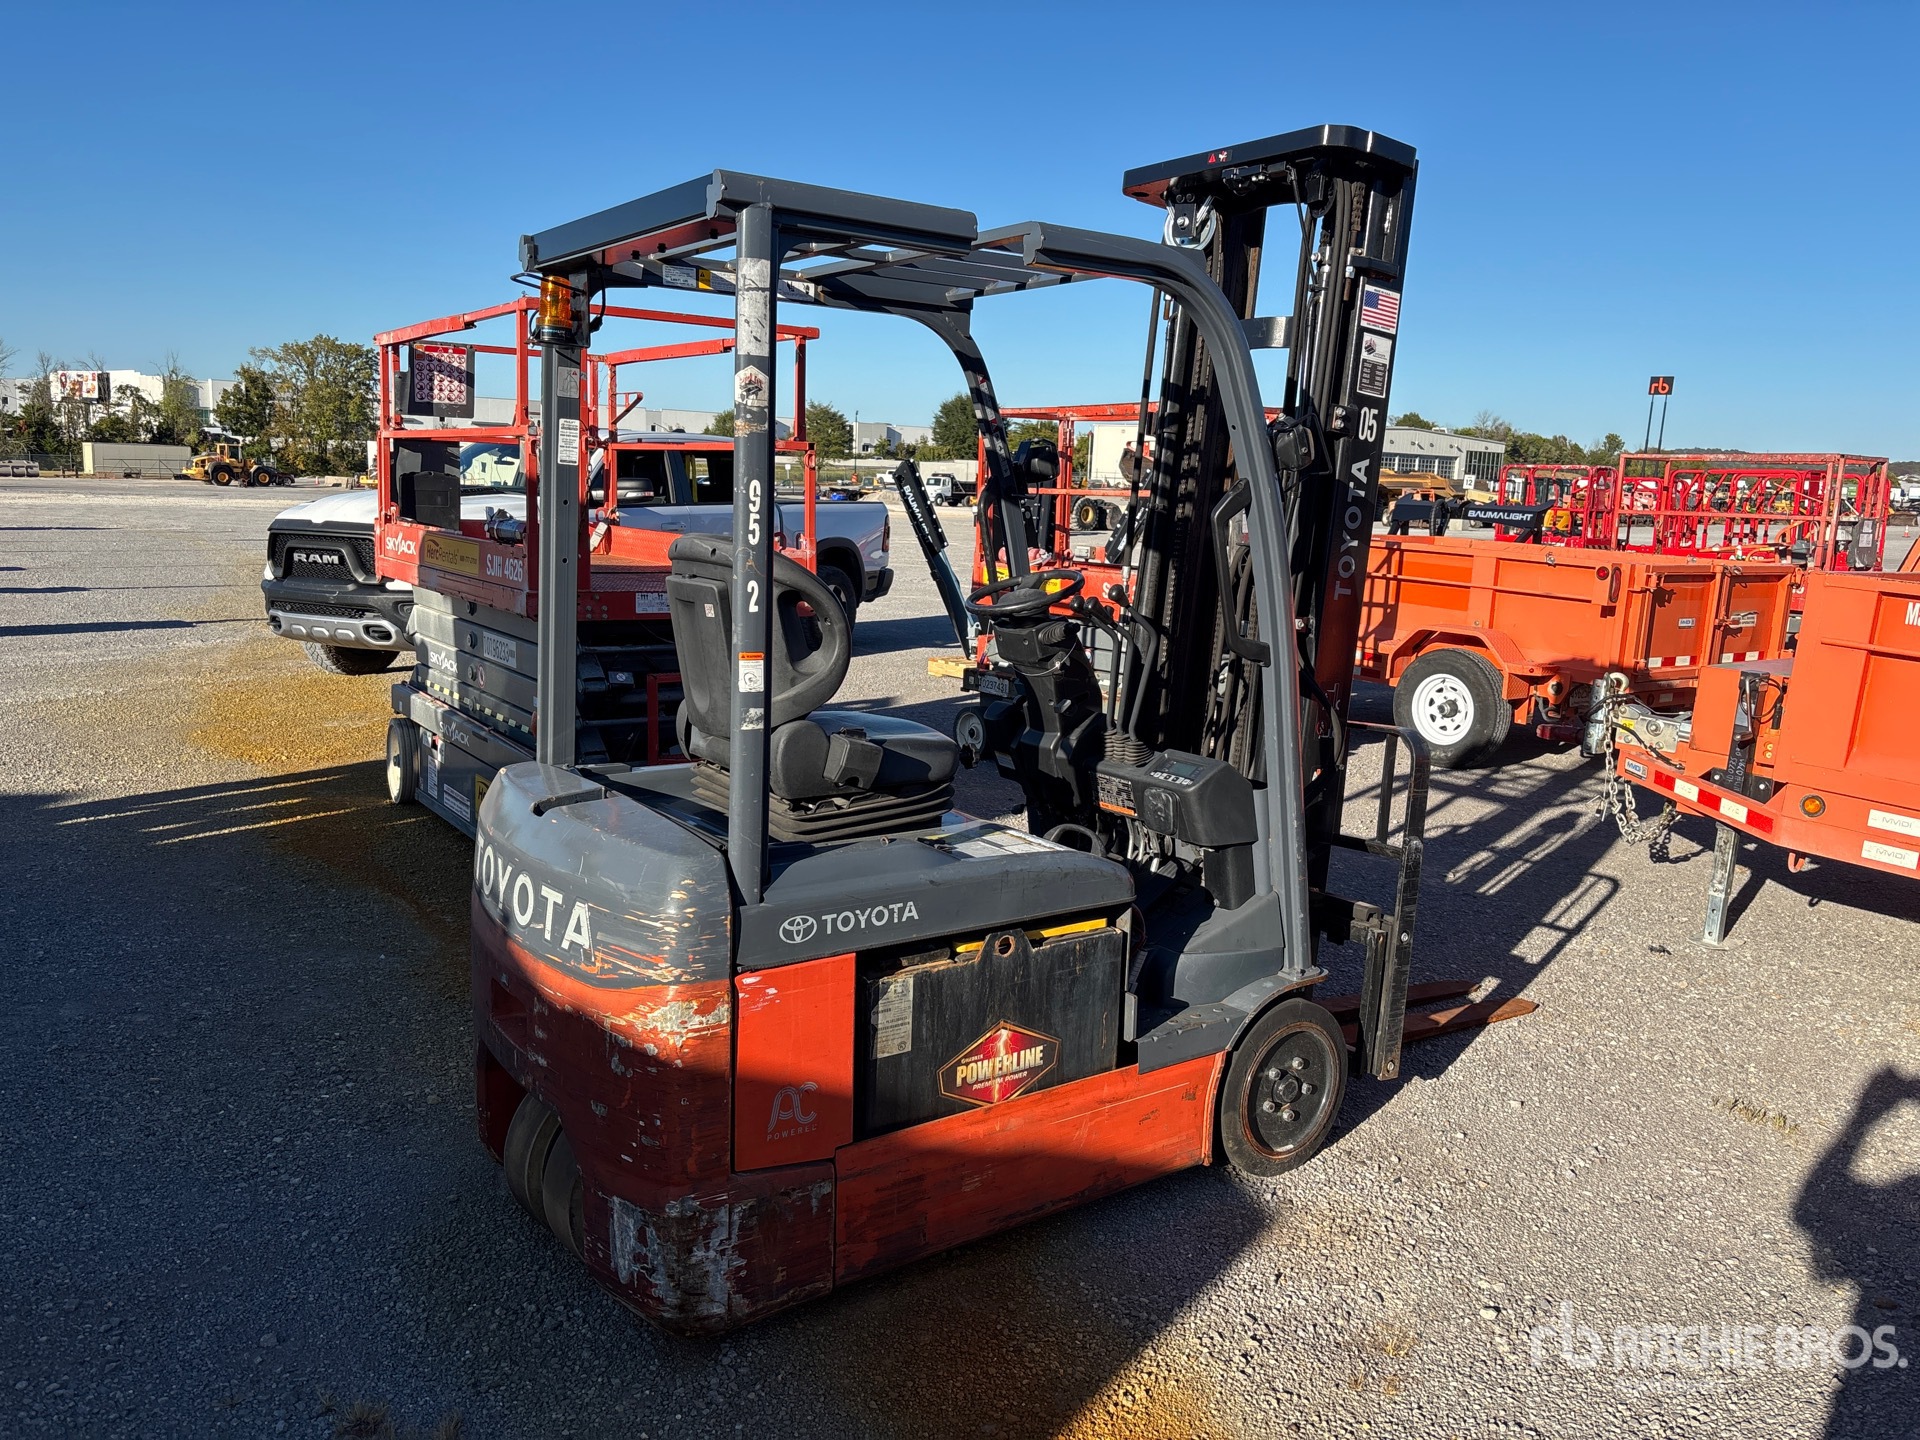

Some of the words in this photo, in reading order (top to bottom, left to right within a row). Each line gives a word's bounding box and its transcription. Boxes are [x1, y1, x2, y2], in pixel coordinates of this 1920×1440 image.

[1650, 377, 1669, 394] rb
[1358, 406, 1378, 442] 05
[1467, 509, 1533, 521] BAUMALIGHT
[1334, 458, 1370, 600] TOYOTA
[385, 531, 416, 555] SKYJACK
[293, 552, 339, 564] RAM
[504, 557, 523, 582] 4626
[430, 650, 459, 674] SKYJACK
[439, 720, 470, 747] SKYJACK
[475, 832, 595, 962] TOYOTA
[821, 901, 919, 935] TOYOTA
[956, 1045, 1044, 1087] POWERLINE
[1004, 1071, 1028, 1082] POWER
